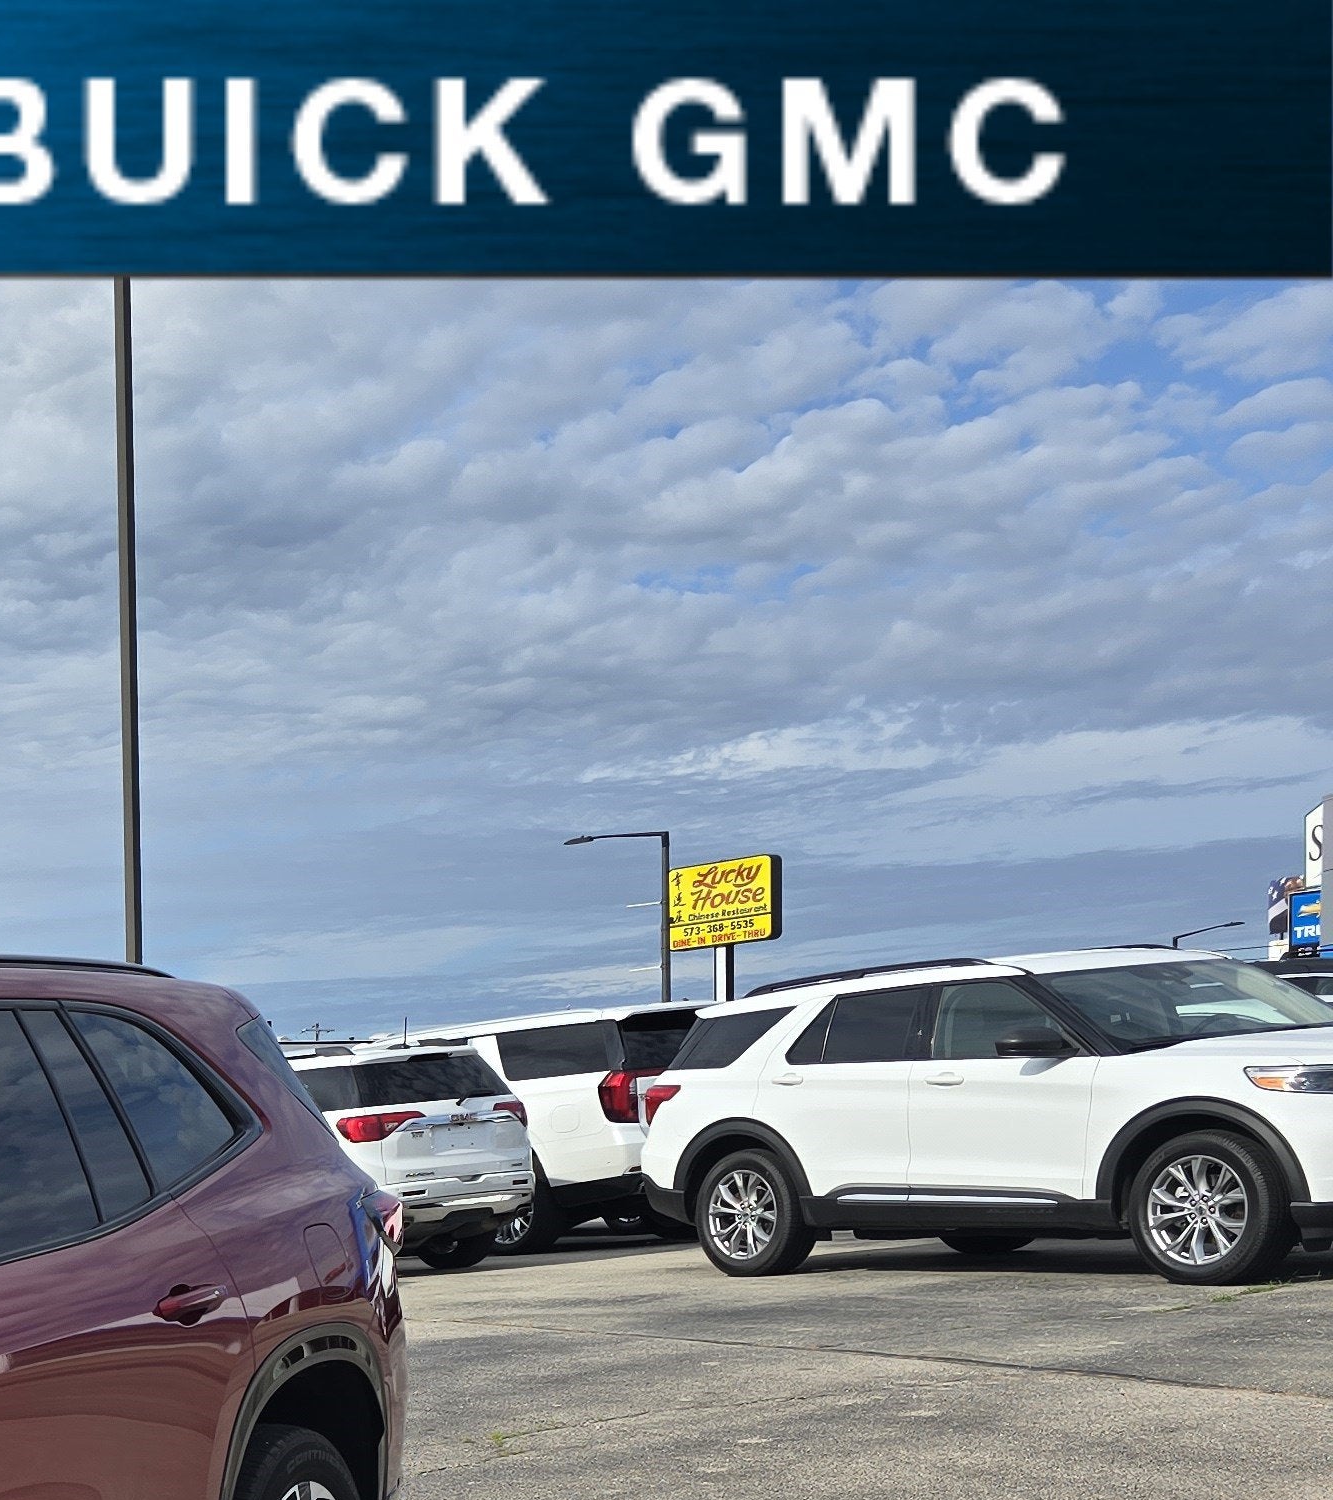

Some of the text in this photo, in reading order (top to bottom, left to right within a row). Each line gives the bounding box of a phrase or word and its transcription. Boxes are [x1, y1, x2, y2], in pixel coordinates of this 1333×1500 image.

[692, 863, 763, 889] Lucky
[690, 886, 766, 912] House
[688, 903, 768, 922] Chinese Restaurant
[683, 918, 755, 937] 573-368-5535
[673, 928, 766, 949] DINE-IN DRIVE-THRU
